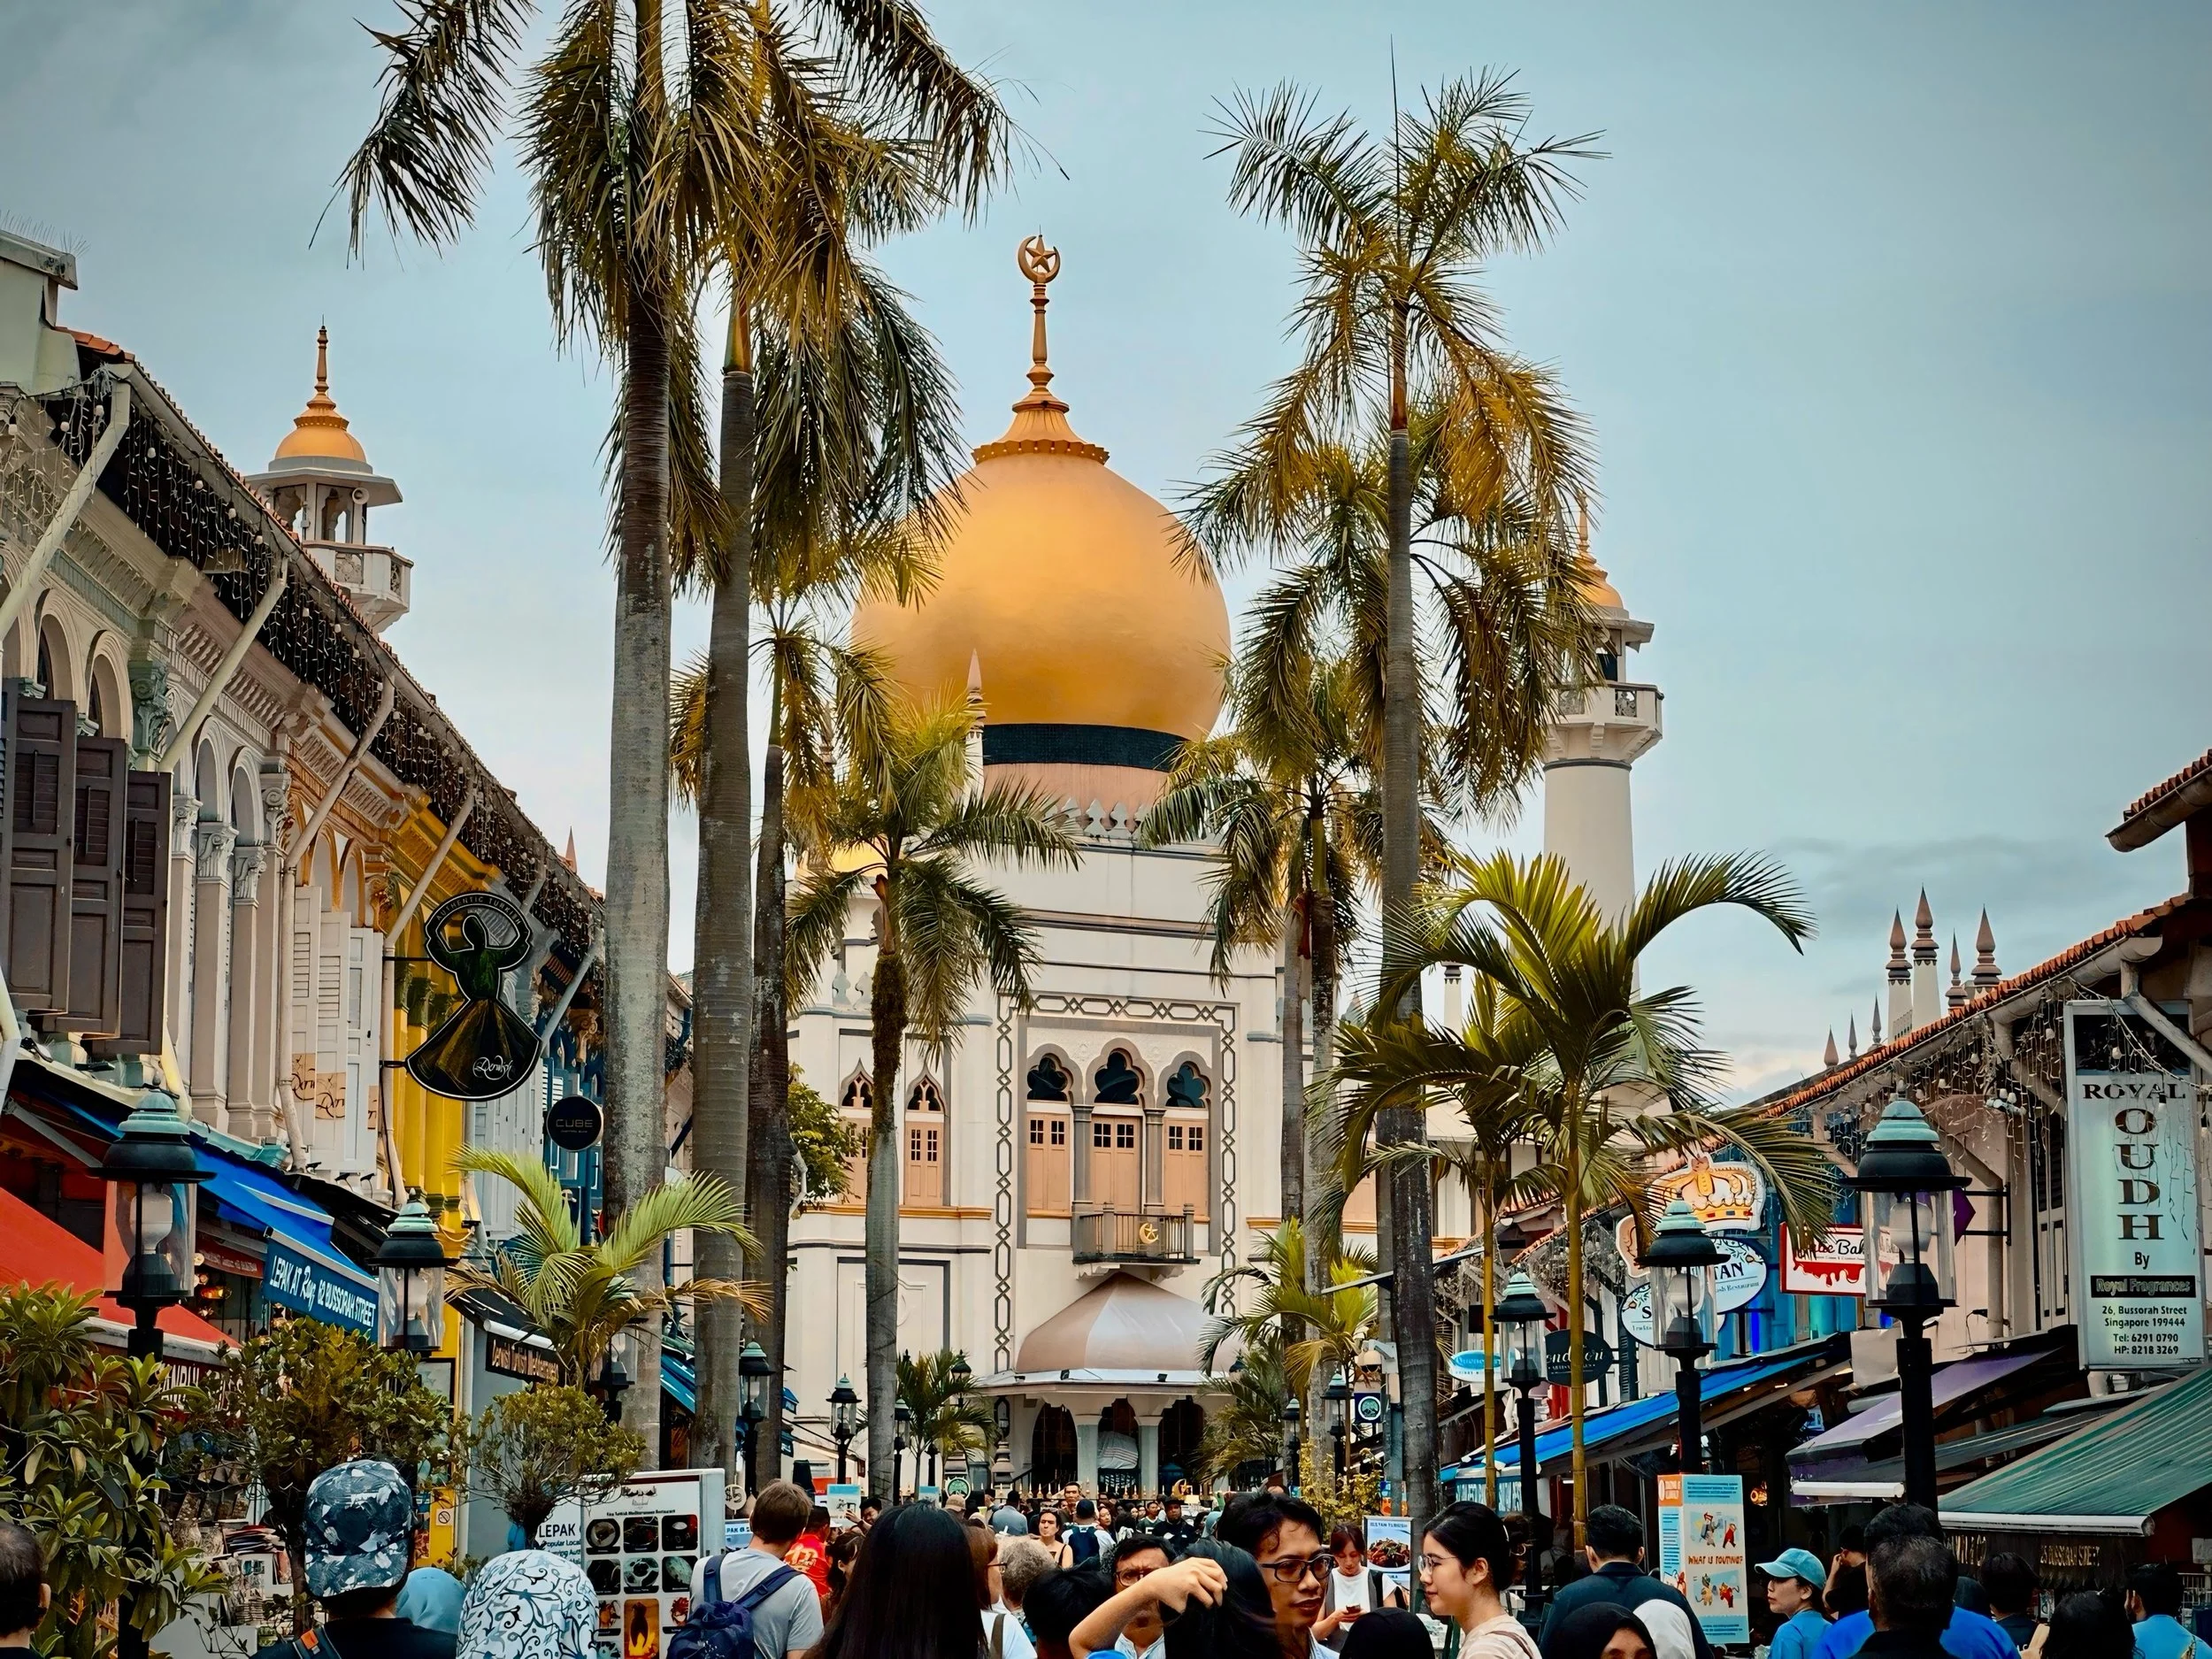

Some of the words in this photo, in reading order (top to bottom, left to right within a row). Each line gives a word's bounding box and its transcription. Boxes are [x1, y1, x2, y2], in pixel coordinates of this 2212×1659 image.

[436, 895, 484, 921] AUTHENTIC
[488, 897, 522, 925] TURKISH
[2082, 1083, 2186, 1099] ROYAL
[556, 1118, 594, 1128] CUBE
[2115, 1108, 2165, 1240] OUDH
[2134, 1251, 2150, 1270] By
[270, 1255, 295, 1293] LEPAK
[290, 1266, 303, 1296] AT
[325, 1282, 356, 1320] BUSSORAH
[354, 1295, 376, 1328] STREET
[2096, 1279, 2128, 1296] Royal
[2102, 1305, 2116, 1316] 26,
[2118, 1305, 2159, 1315] Bussorah
[2161, 1305, 2187, 1315] Street
[2105, 1317, 2150, 1328] Singapore
[2153, 1317, 2185, 1327] 199444
[2113, 1333, 2129, 1342] Tel:
[2131, 1333, 2153, 1342] 6291
[2156, 1333, 2178, 1342] 0790
[2114, 1345, 2130, 1355] HP:
[2131, 1345, 2154, 1355] 8218
[2156, 1345, 2178, 1355] 3269
[725, 1486, 742, 1503] $5
[539, 1523, 576, 1538] LEPAK
